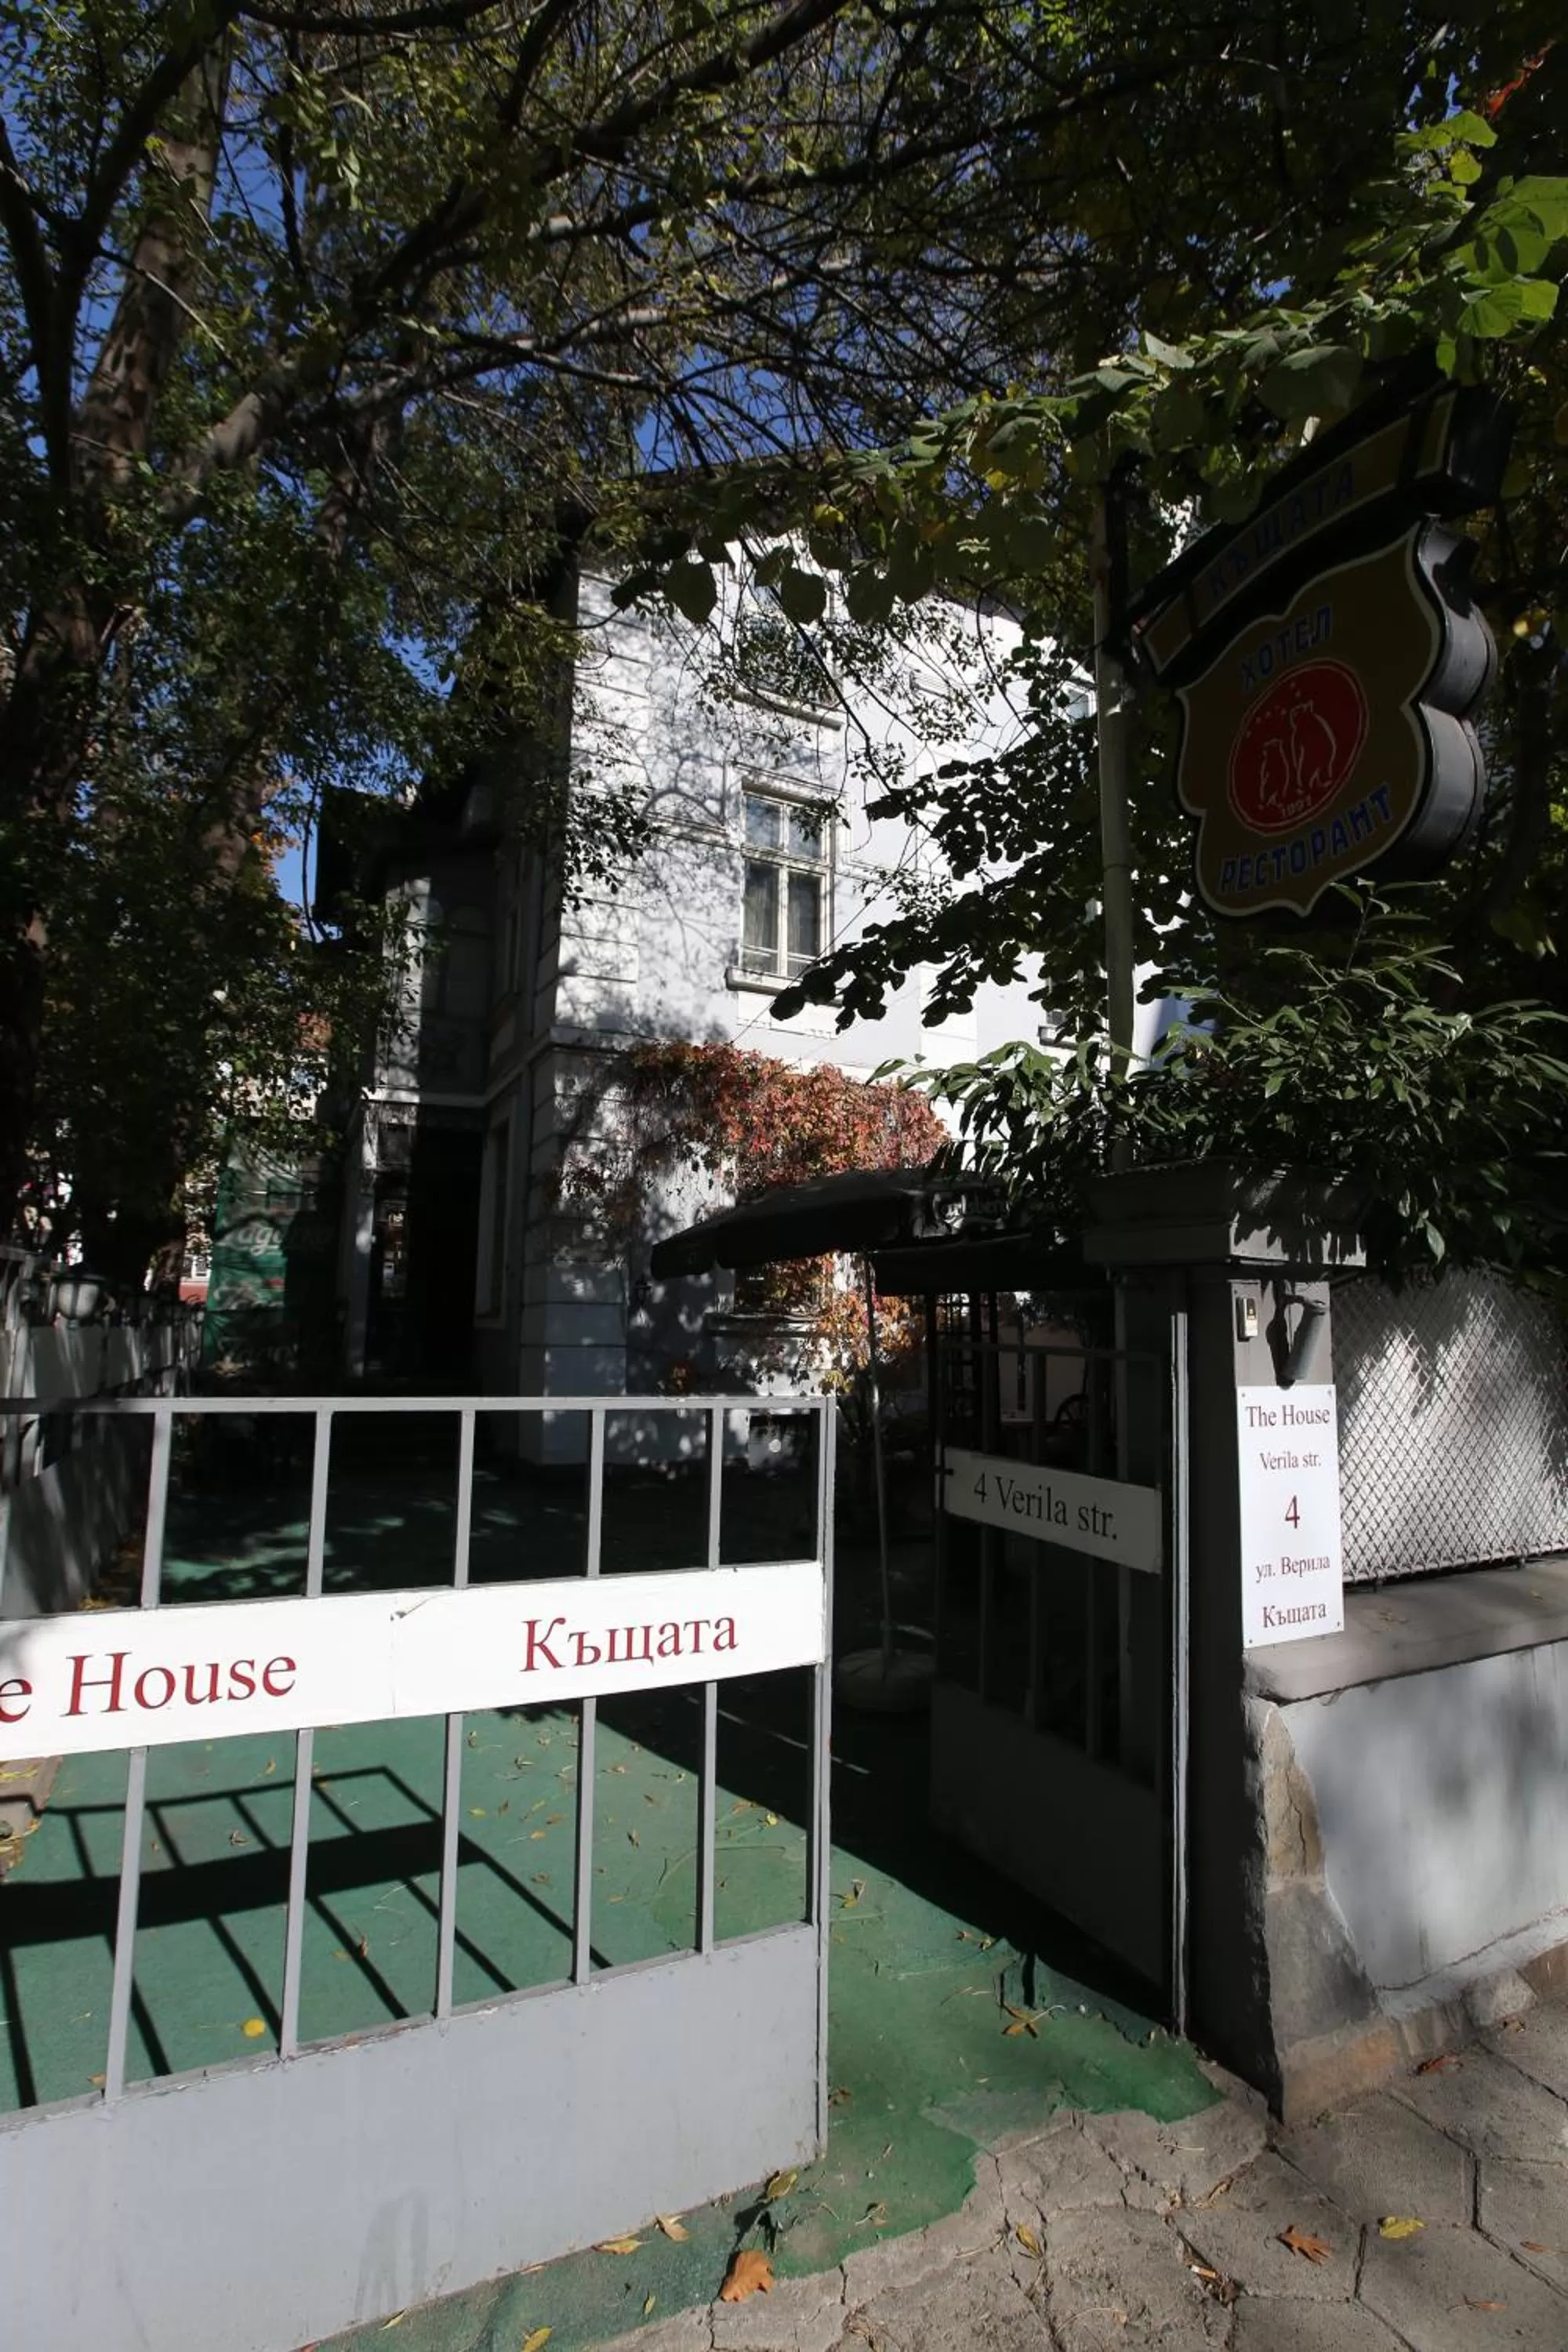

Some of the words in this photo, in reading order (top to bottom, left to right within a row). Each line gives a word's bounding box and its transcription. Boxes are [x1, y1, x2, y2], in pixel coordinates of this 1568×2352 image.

[1209, 461, 1354, 599] КЪЩАТА
[1239, 605, 1332, 690] ХОТЕЛ
[1218, 783, 1395, 895] РЕСТОРАНТ
[1246, 1406, 1276, 1426] The
[1282, 1404, 1330, 1426] House
[1259, 1452, 1299, 1471] Verila
[1302, 1454, 1321, 1468] str.
[974, 1472, 987, 1503] 4
[995, 1475, 1068, 1526] Verila
[1077, 1502, 1117, 1540] str.
[1284, 1494, 1301, 1530] 4
[1254, 1566, 1276, 1584] ул.
[1281, 1555, 1330, 1578] Верила
[1262, 1602, 1327, 1628] Къщата
[520, 1616, 739, 1672] Къщата
[61, 1651, 296, 1716] House
